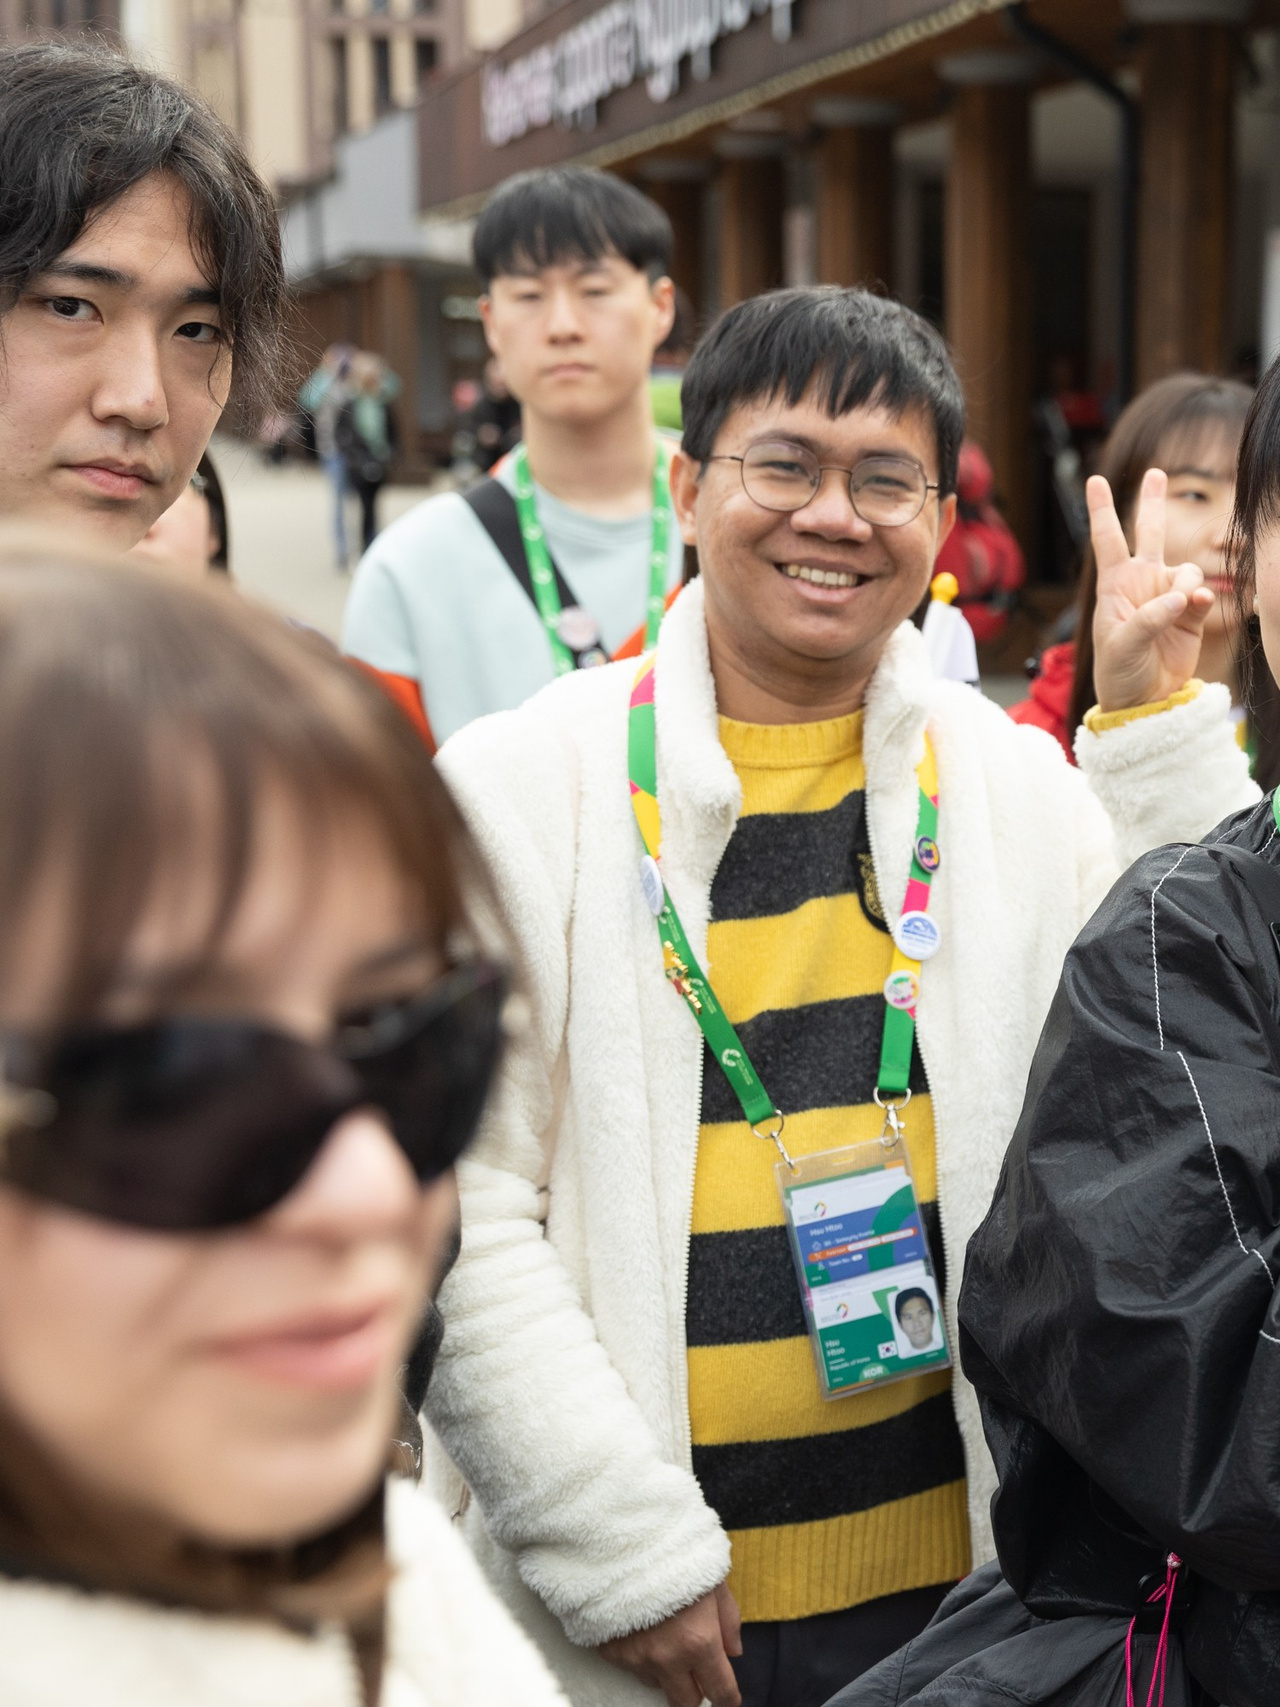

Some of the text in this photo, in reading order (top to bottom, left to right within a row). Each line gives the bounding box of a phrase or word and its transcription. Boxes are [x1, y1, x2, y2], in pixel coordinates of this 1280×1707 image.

[810, 1228, 825, 1237] Hsu
[825, 1339, 840, 1348] Hsu
[863, 1366, 884, 1378] KOR
